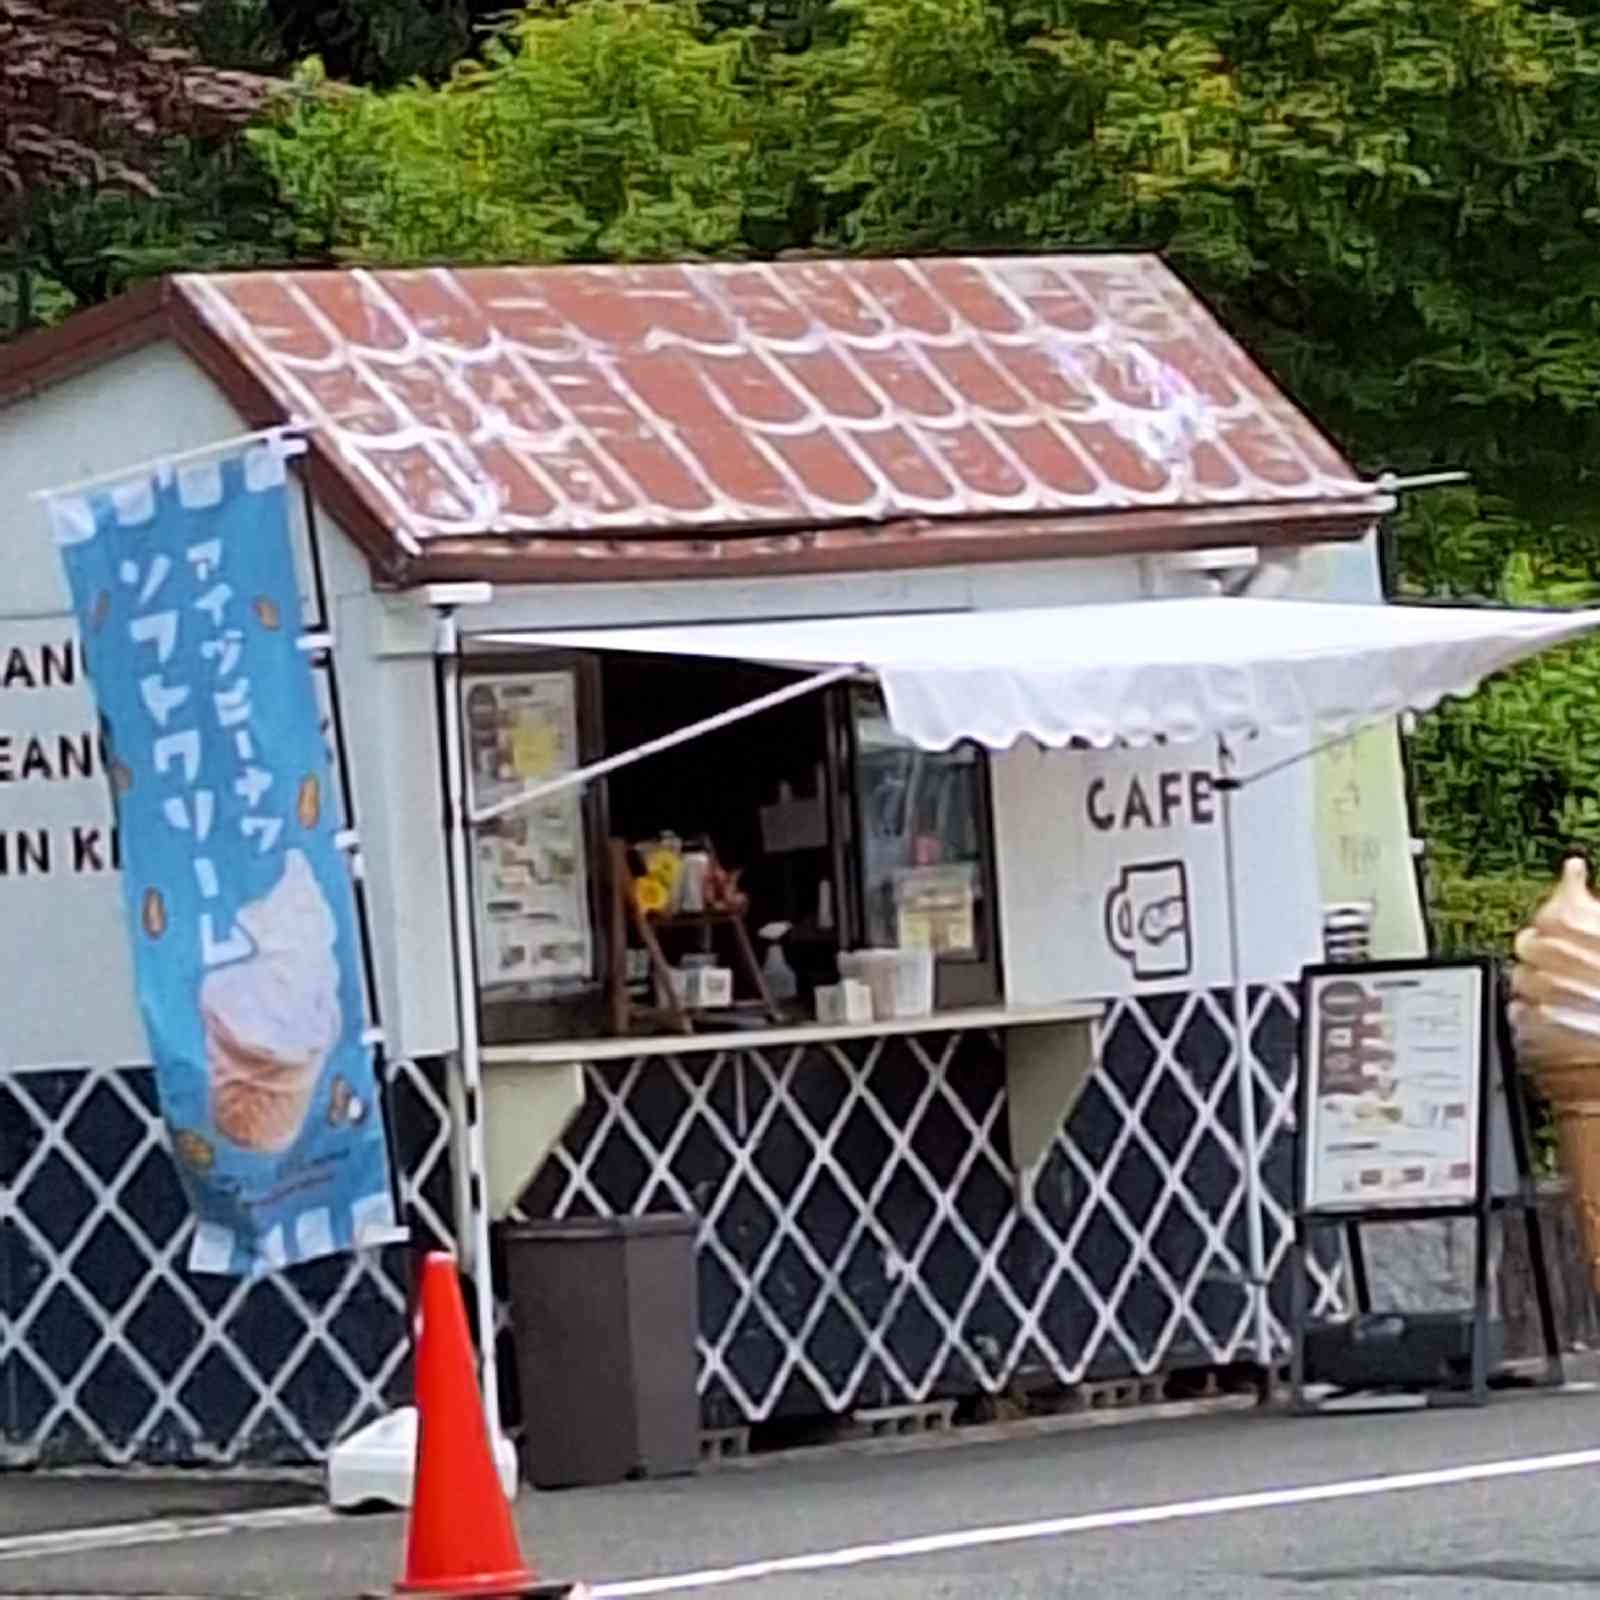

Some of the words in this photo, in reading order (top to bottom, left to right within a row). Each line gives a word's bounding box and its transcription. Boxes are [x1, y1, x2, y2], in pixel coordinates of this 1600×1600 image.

[0, 731, 108, 781] EAN
[118, 554, 254, 968] ソフトクリーム
[1085, 770, 1214, 831] CAFE
